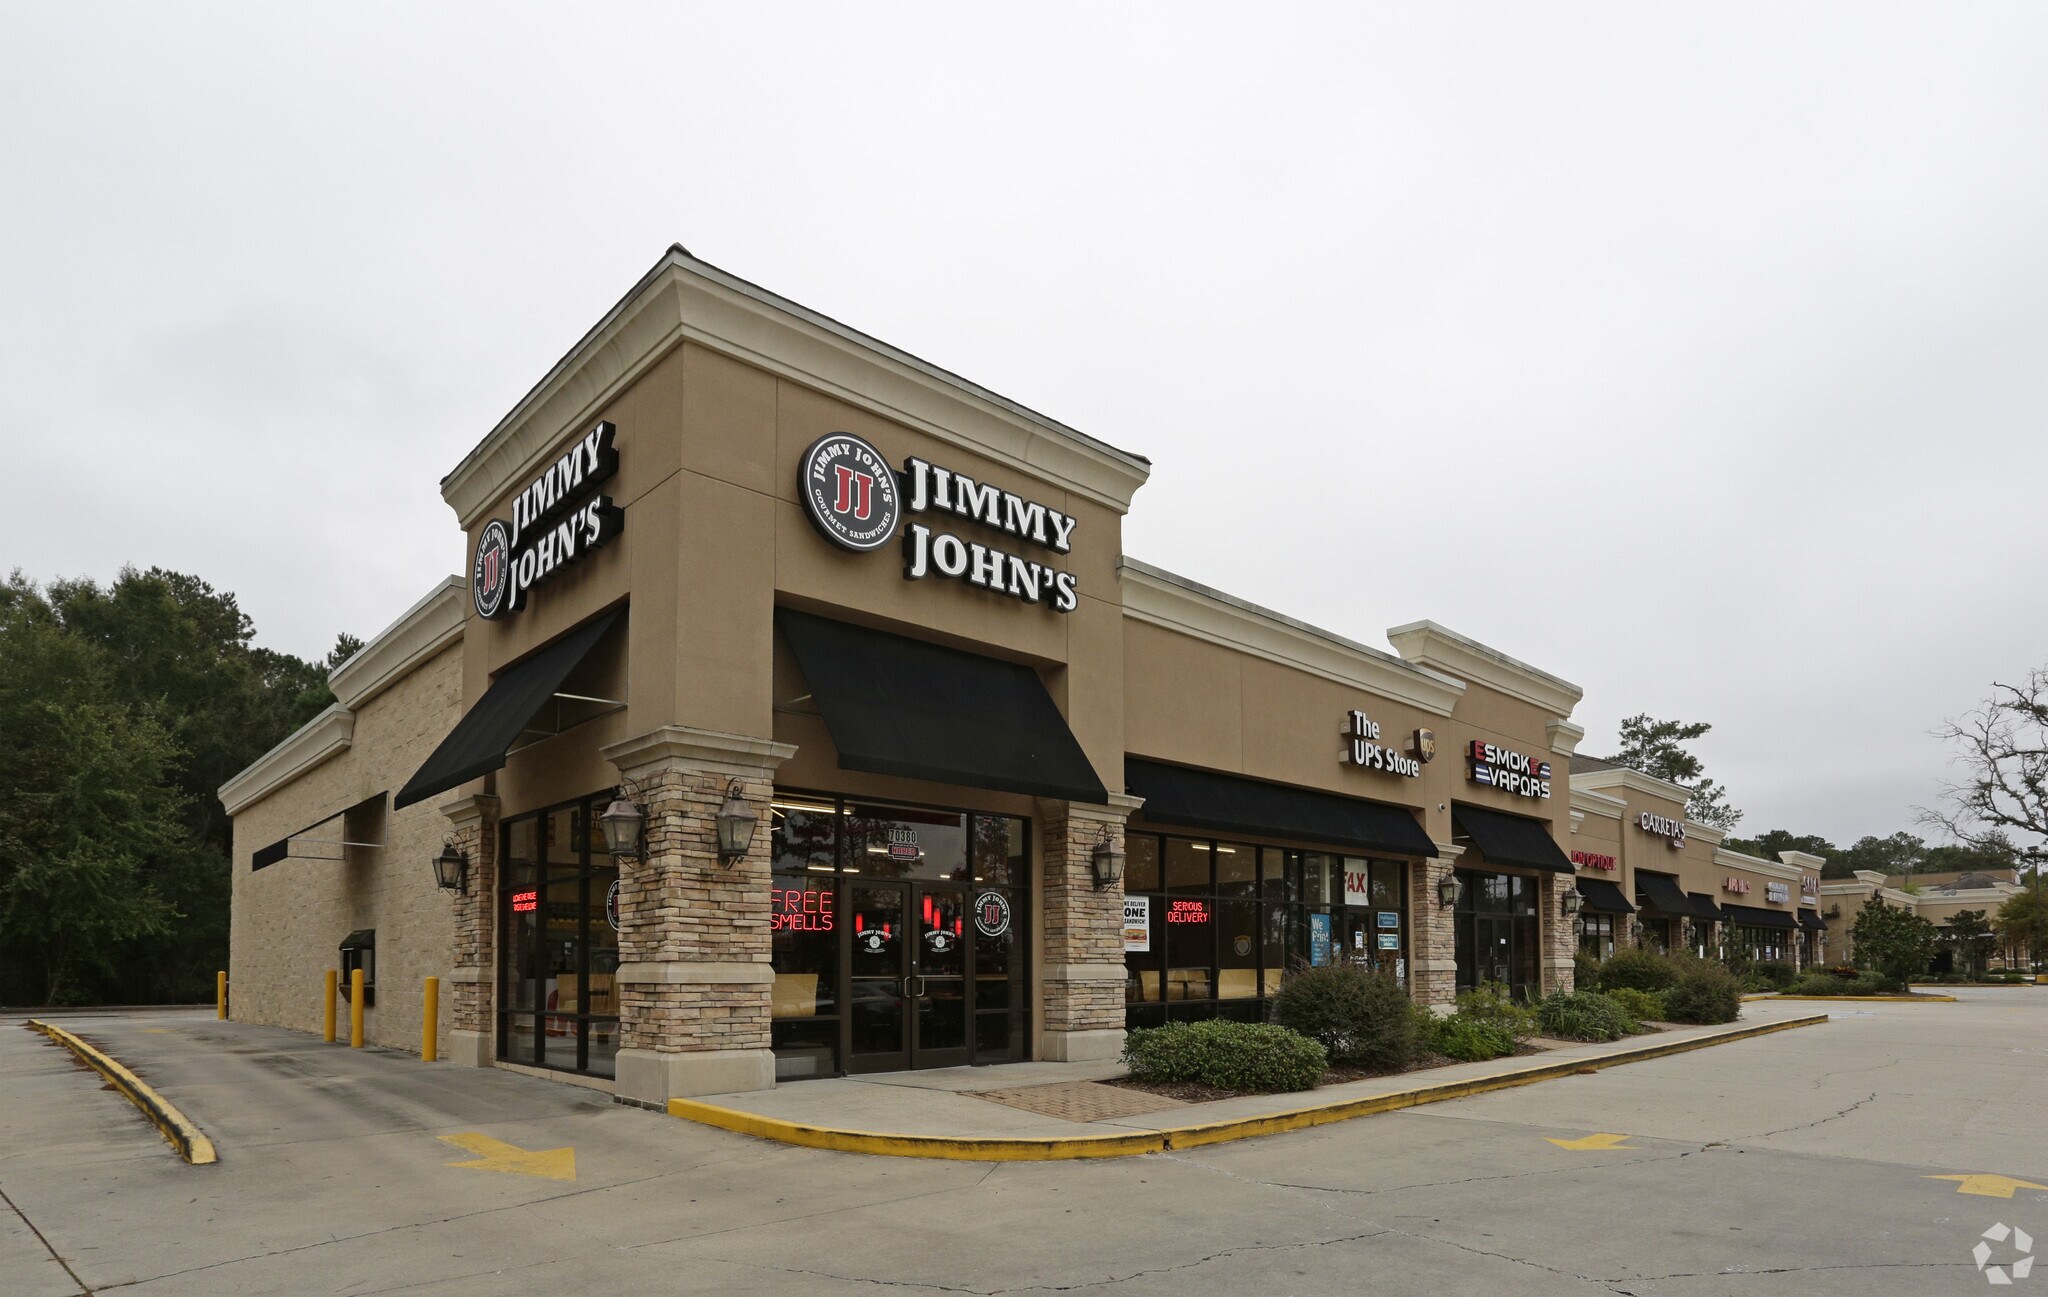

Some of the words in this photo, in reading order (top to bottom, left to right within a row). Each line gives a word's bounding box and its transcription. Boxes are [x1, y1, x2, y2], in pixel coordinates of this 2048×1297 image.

[813, 443, 850, 482] JIMMY
[855, 448, 892, 502] JOHN'S
[512, 422, 604, 548] JIMMY
[834, 463, 874, 520] JJ
[815, 489, 847, 533] GOURMET
[850, 512, 891, 539] SANDWICHES
[911, 458, 1077, 550] JIMMY
[509, 495, 601, 610] JOHN'S
[483, 545, 499, 596] JJ
[911, 524, 1079, 611] JOHN'S
[1354, 709, 1380, 739] The
[1421, 738, 1435, 757] ups
[1354, 739, 1383, 769] UPS
[1386, 748, 1420, 778] Store
[889, 829, 917, 843] 70380
[1641, 812, 1686, 840] CARRETA'S
[1587, 853, 1617, 871] OPTIQUE
[984, 904, 1000, 925] JJ
[1124, 907, 1146, 918] ONE
[1172, 901, 1203, 911] SERIOUS
[770, 913, 833, 931] SMELLS
[1167, 911, 1208, 923] DELIVERY
[1311, 918, 1324, 930] We
[857, 929, 874, 938] JIMMY
[924, 930, 940, 939] JIMMY
[1312, 930, 1329, 942] Print
